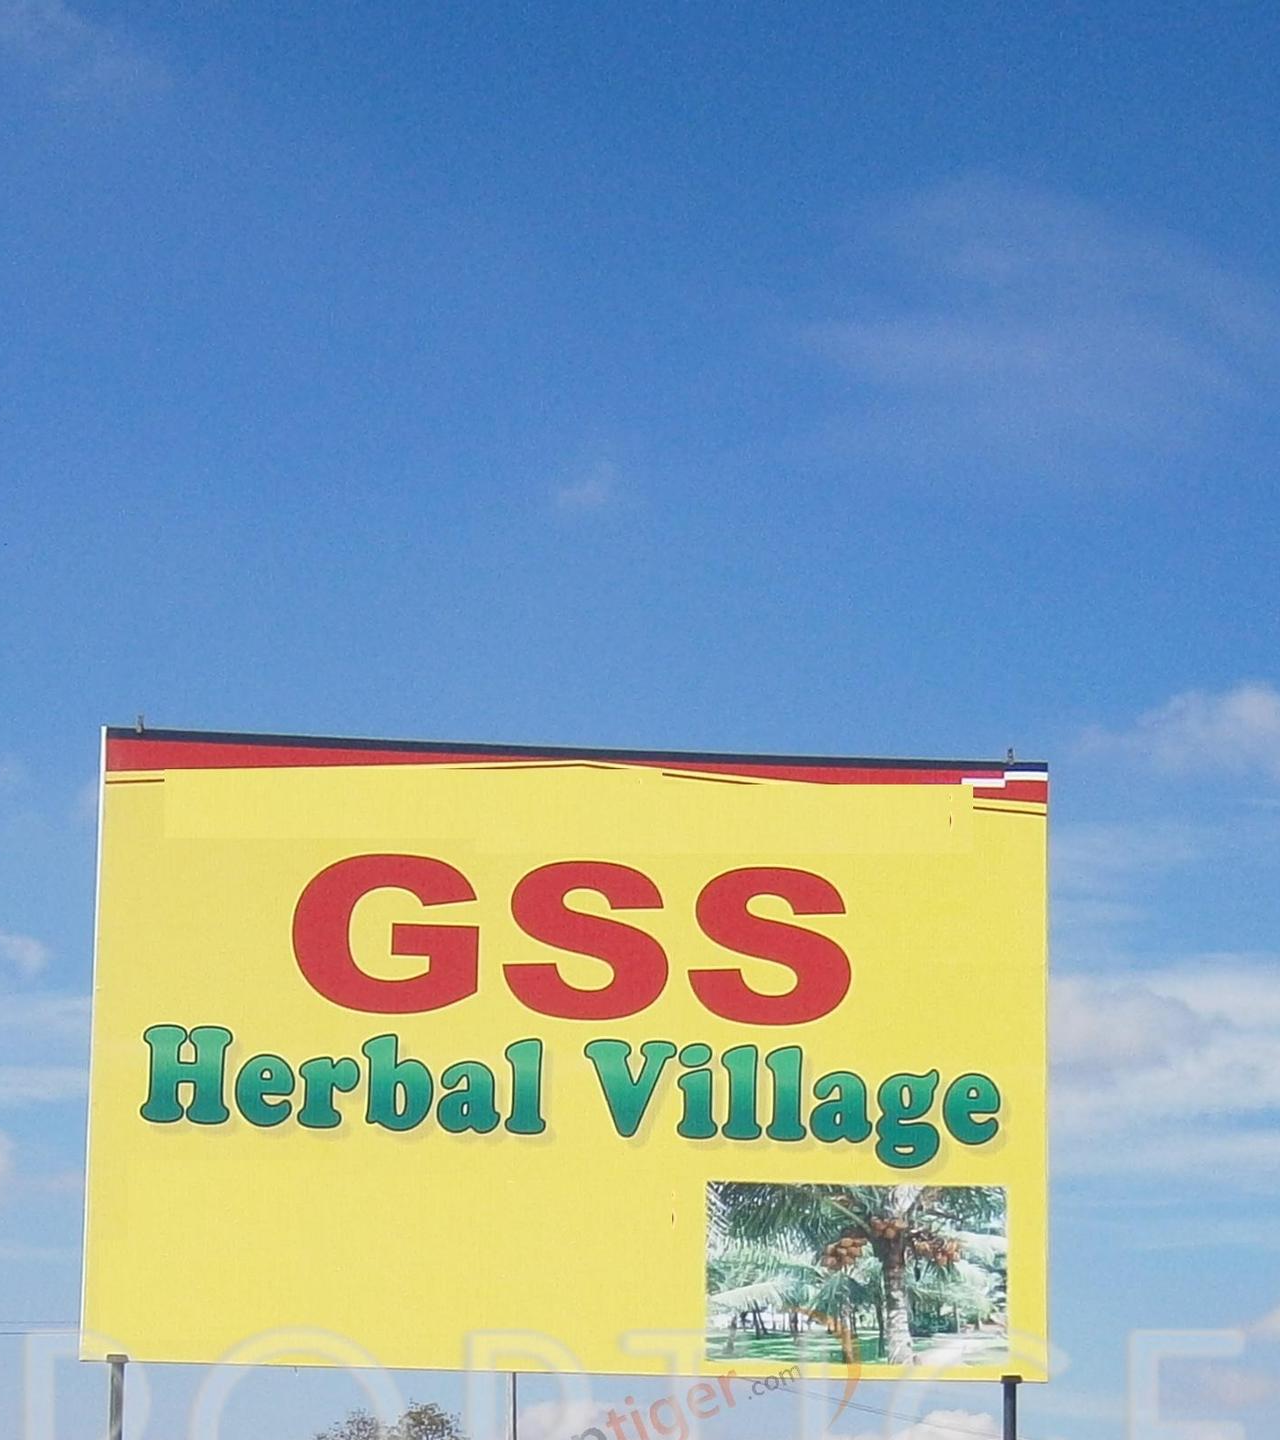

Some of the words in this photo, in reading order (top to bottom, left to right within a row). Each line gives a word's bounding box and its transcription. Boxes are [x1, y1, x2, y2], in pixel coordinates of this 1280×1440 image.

[291, 853, 852, 1026] GSS
[140, 1023, 547, 1135] Herbal
[583, 1038, 1003, 1169] Village
